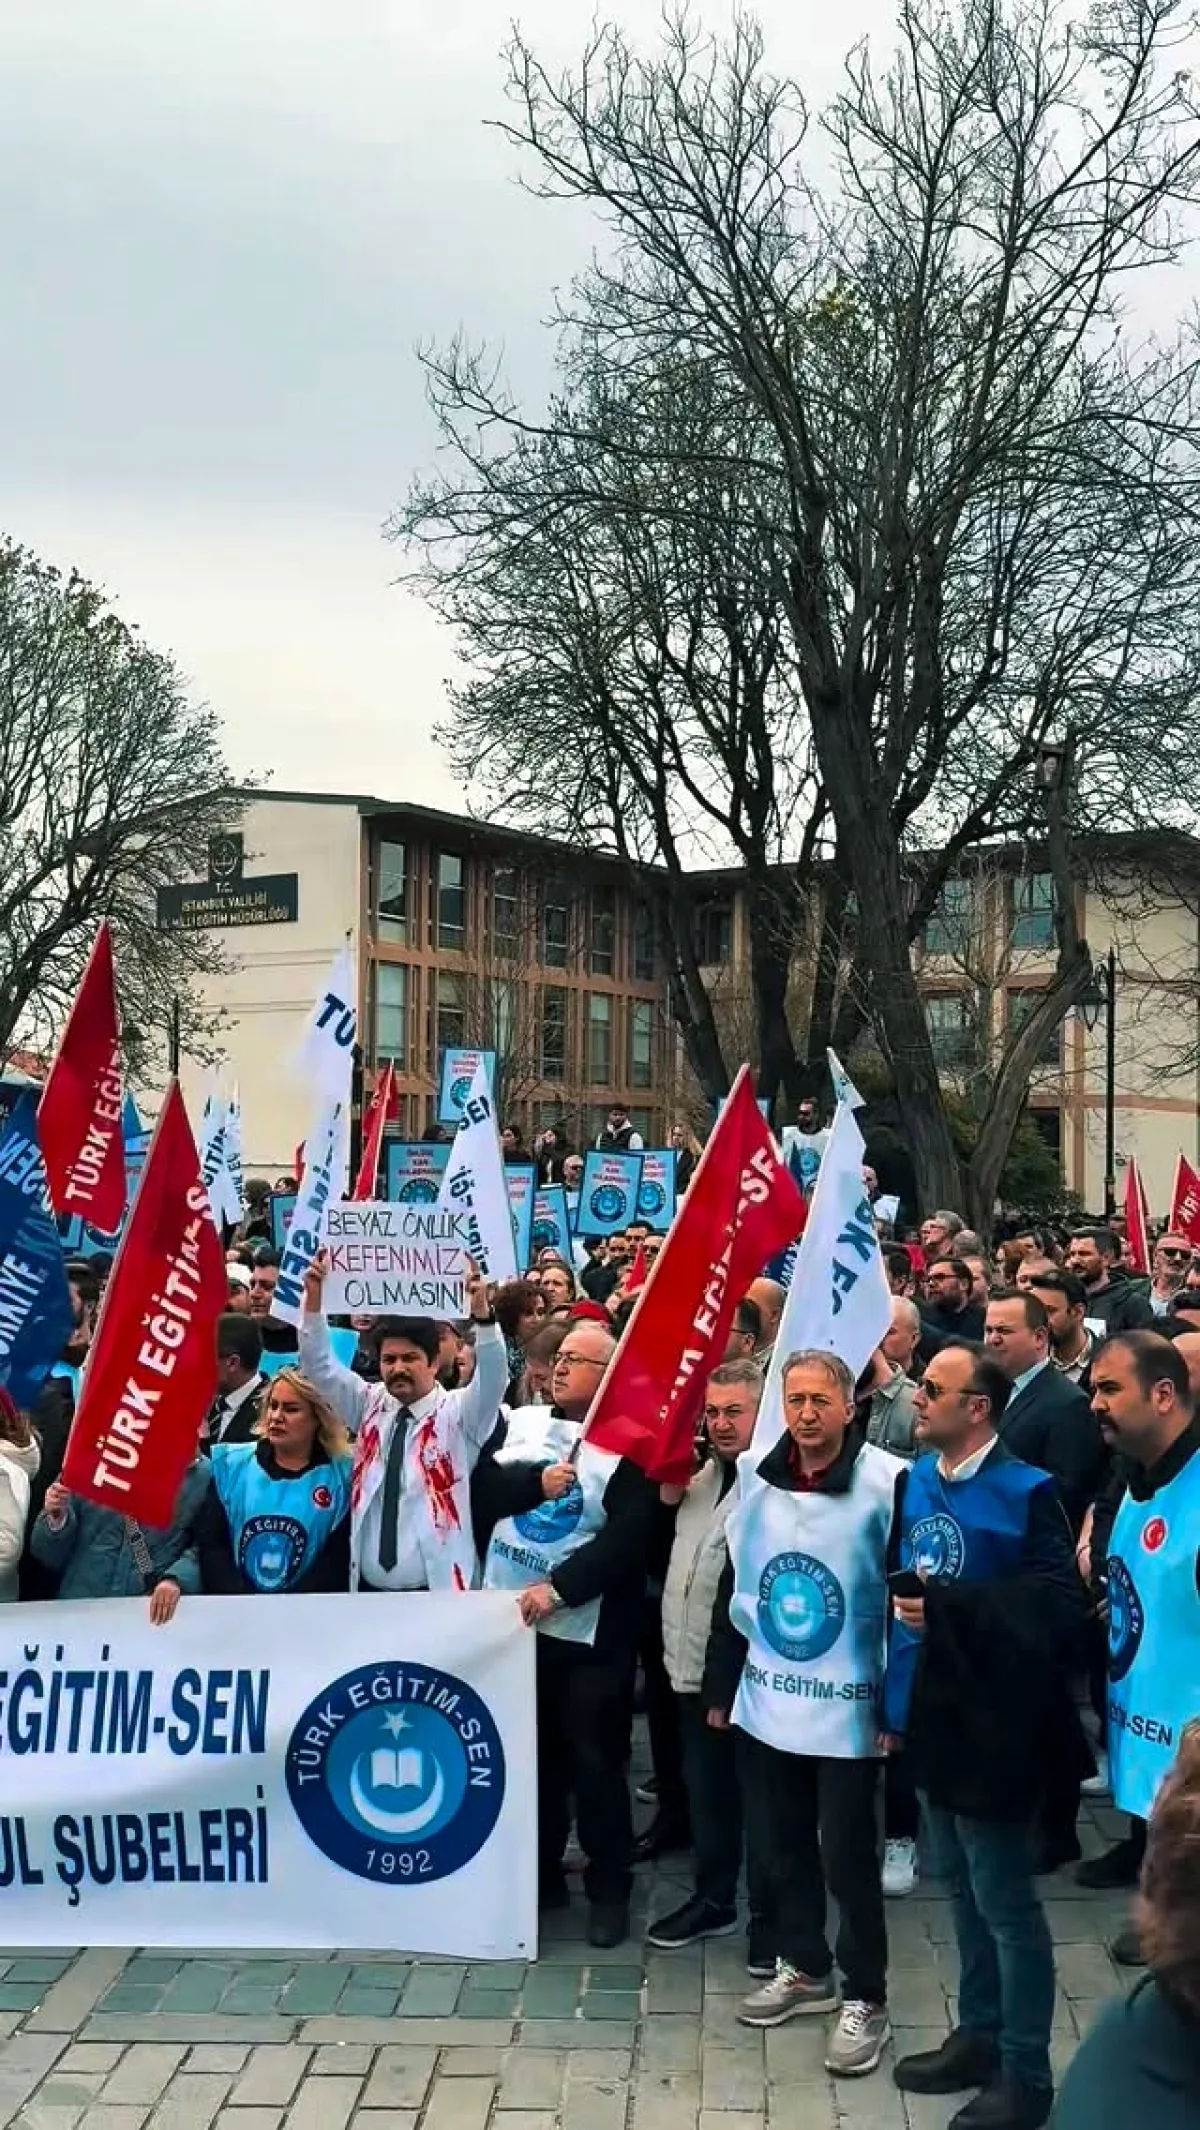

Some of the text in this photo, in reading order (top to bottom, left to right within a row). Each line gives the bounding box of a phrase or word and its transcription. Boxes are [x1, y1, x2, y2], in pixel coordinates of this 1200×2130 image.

[64, 1123, 114, 1201] TÜRK
[327, 1209, 397, 1237] BEYAZ
[344, 1280, 464, 1314] OLMASIN!
[93, 1376, 163, 1492] TÜRK
[298, 1669, 492, 1788] TÜRK EĞİTİM-SEN
[53, 1785, 269, 1907] ŞUBELERİ
[366, 1848, 434, 1876] 1992
